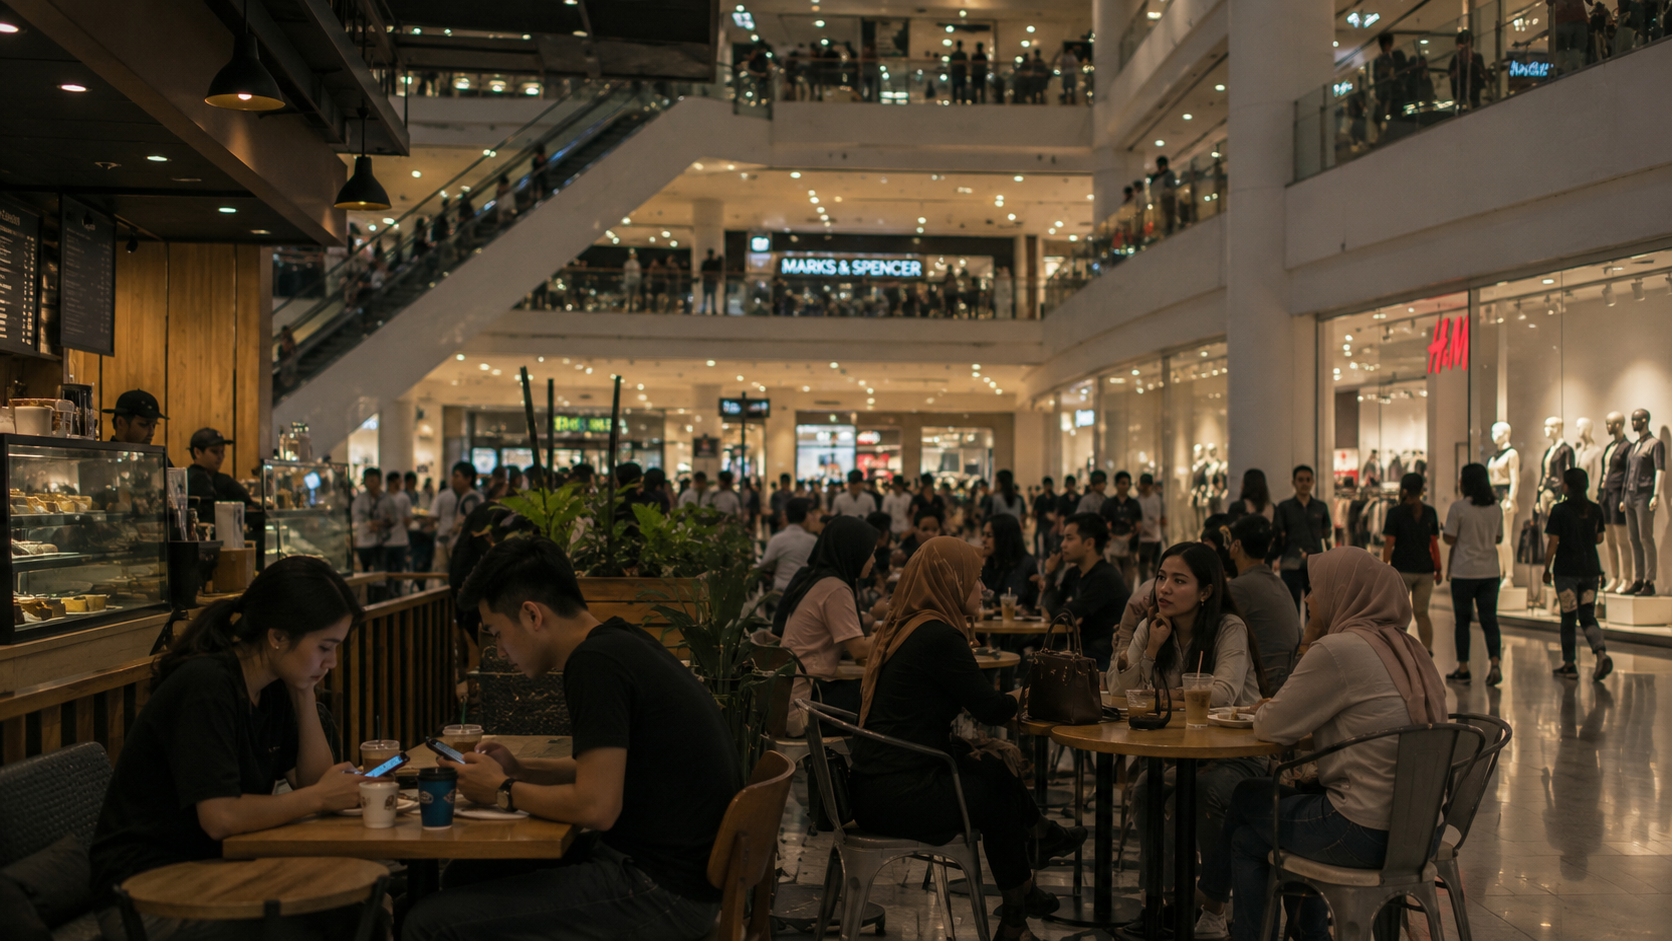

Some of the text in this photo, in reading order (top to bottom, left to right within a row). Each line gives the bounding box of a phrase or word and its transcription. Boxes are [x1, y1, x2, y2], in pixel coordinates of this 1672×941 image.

[781, 258, 922, 276] MARKS & SPENCER
[1427, 315, 1469, 374] H&M
